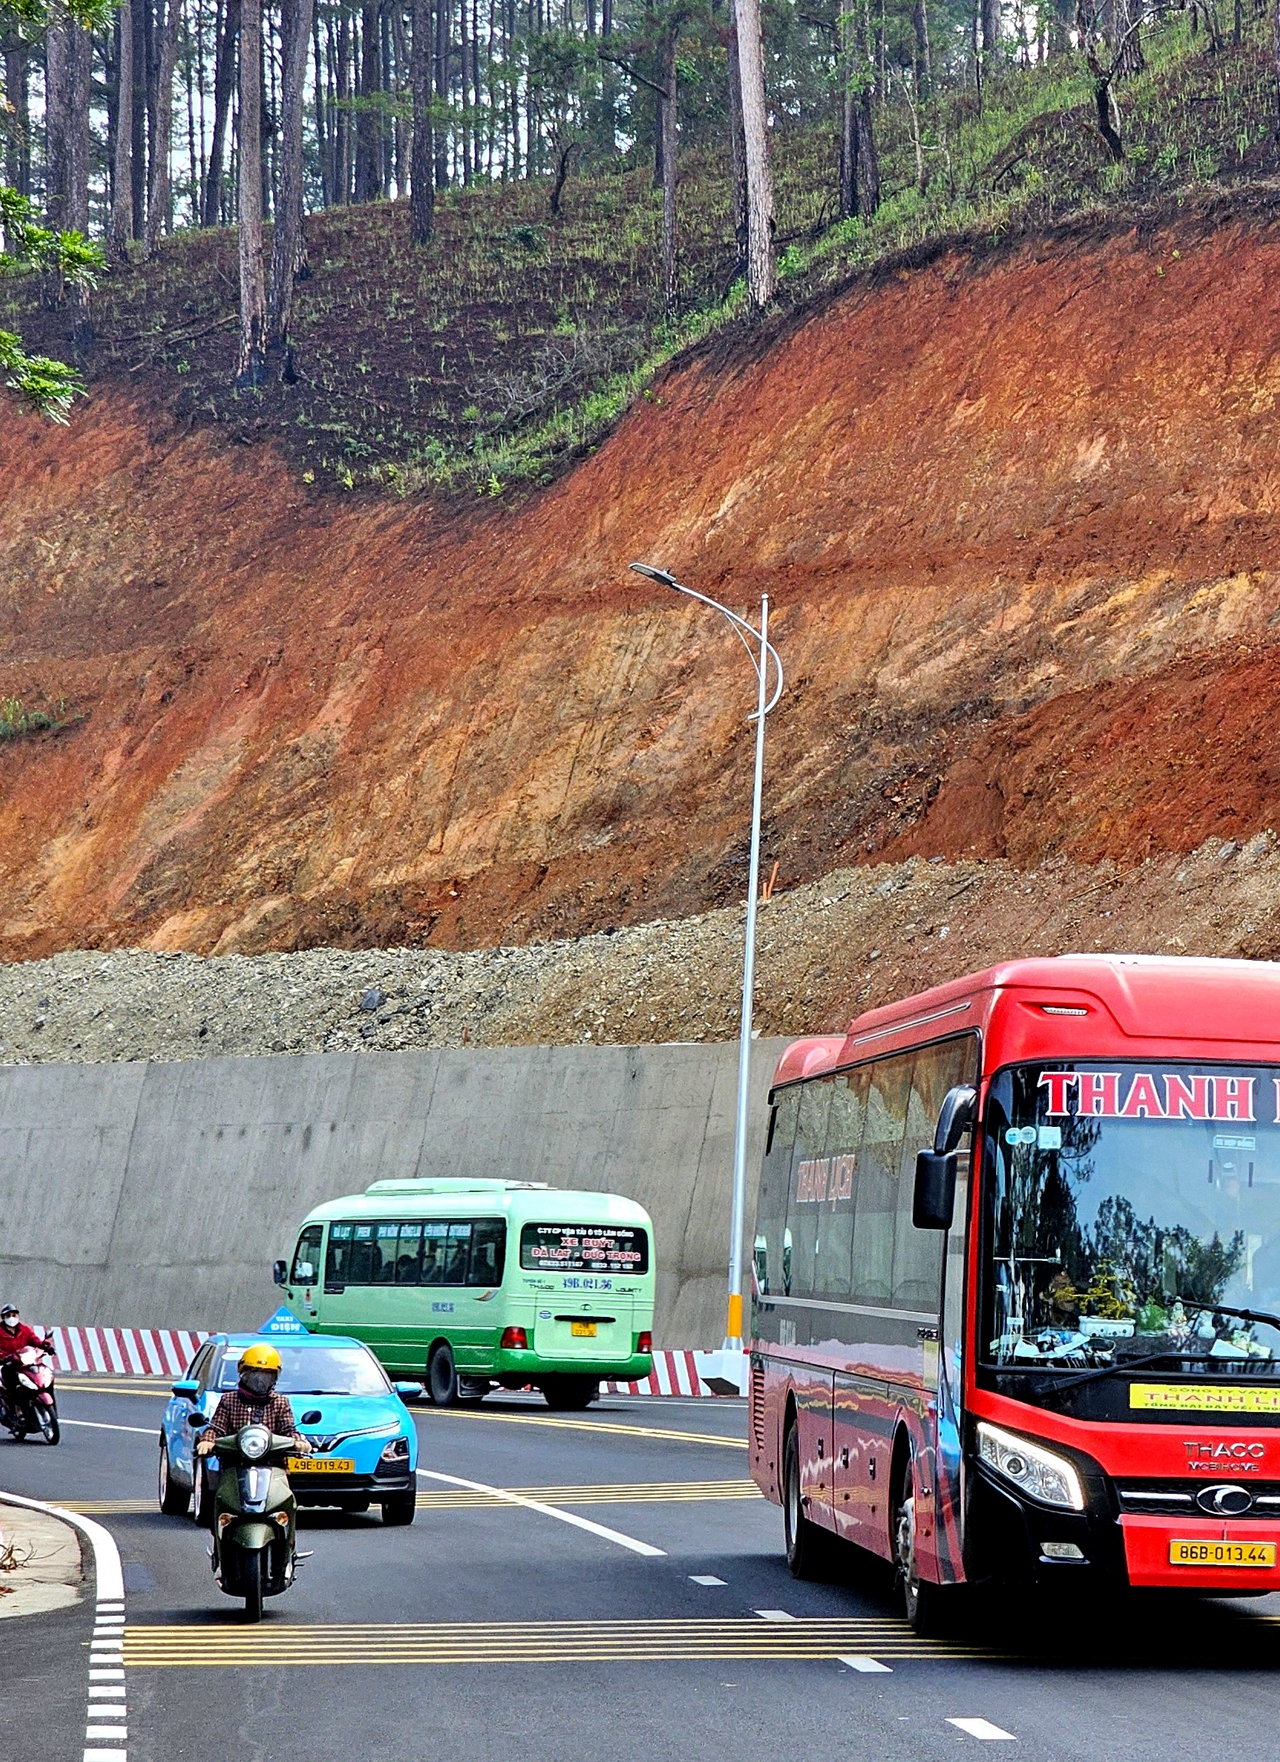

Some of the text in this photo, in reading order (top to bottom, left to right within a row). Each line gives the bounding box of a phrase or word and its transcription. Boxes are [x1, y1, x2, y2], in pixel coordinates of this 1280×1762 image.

[1037, 1072, 1256, 1121] THANH
[796, 1158, 830, 1203] THANH
[561, 1237, 615, 1248] XE BUÝT
[532, 1245, 548, 1257] ĐÀ
[550, 1249, 571, 1260] LẠT
[582, 1248, 605, 1260] ĐỨC
[606, 1251, 641, 1263] TRỌNG
[1144, 1393, 1244, 1402] THANH
[1183, 1441, 1264, 1458] THACO
[294, 1461, 350, 1471] 49E-019.43
[1180, 1545, 1266, 1562] 86B-013.44
